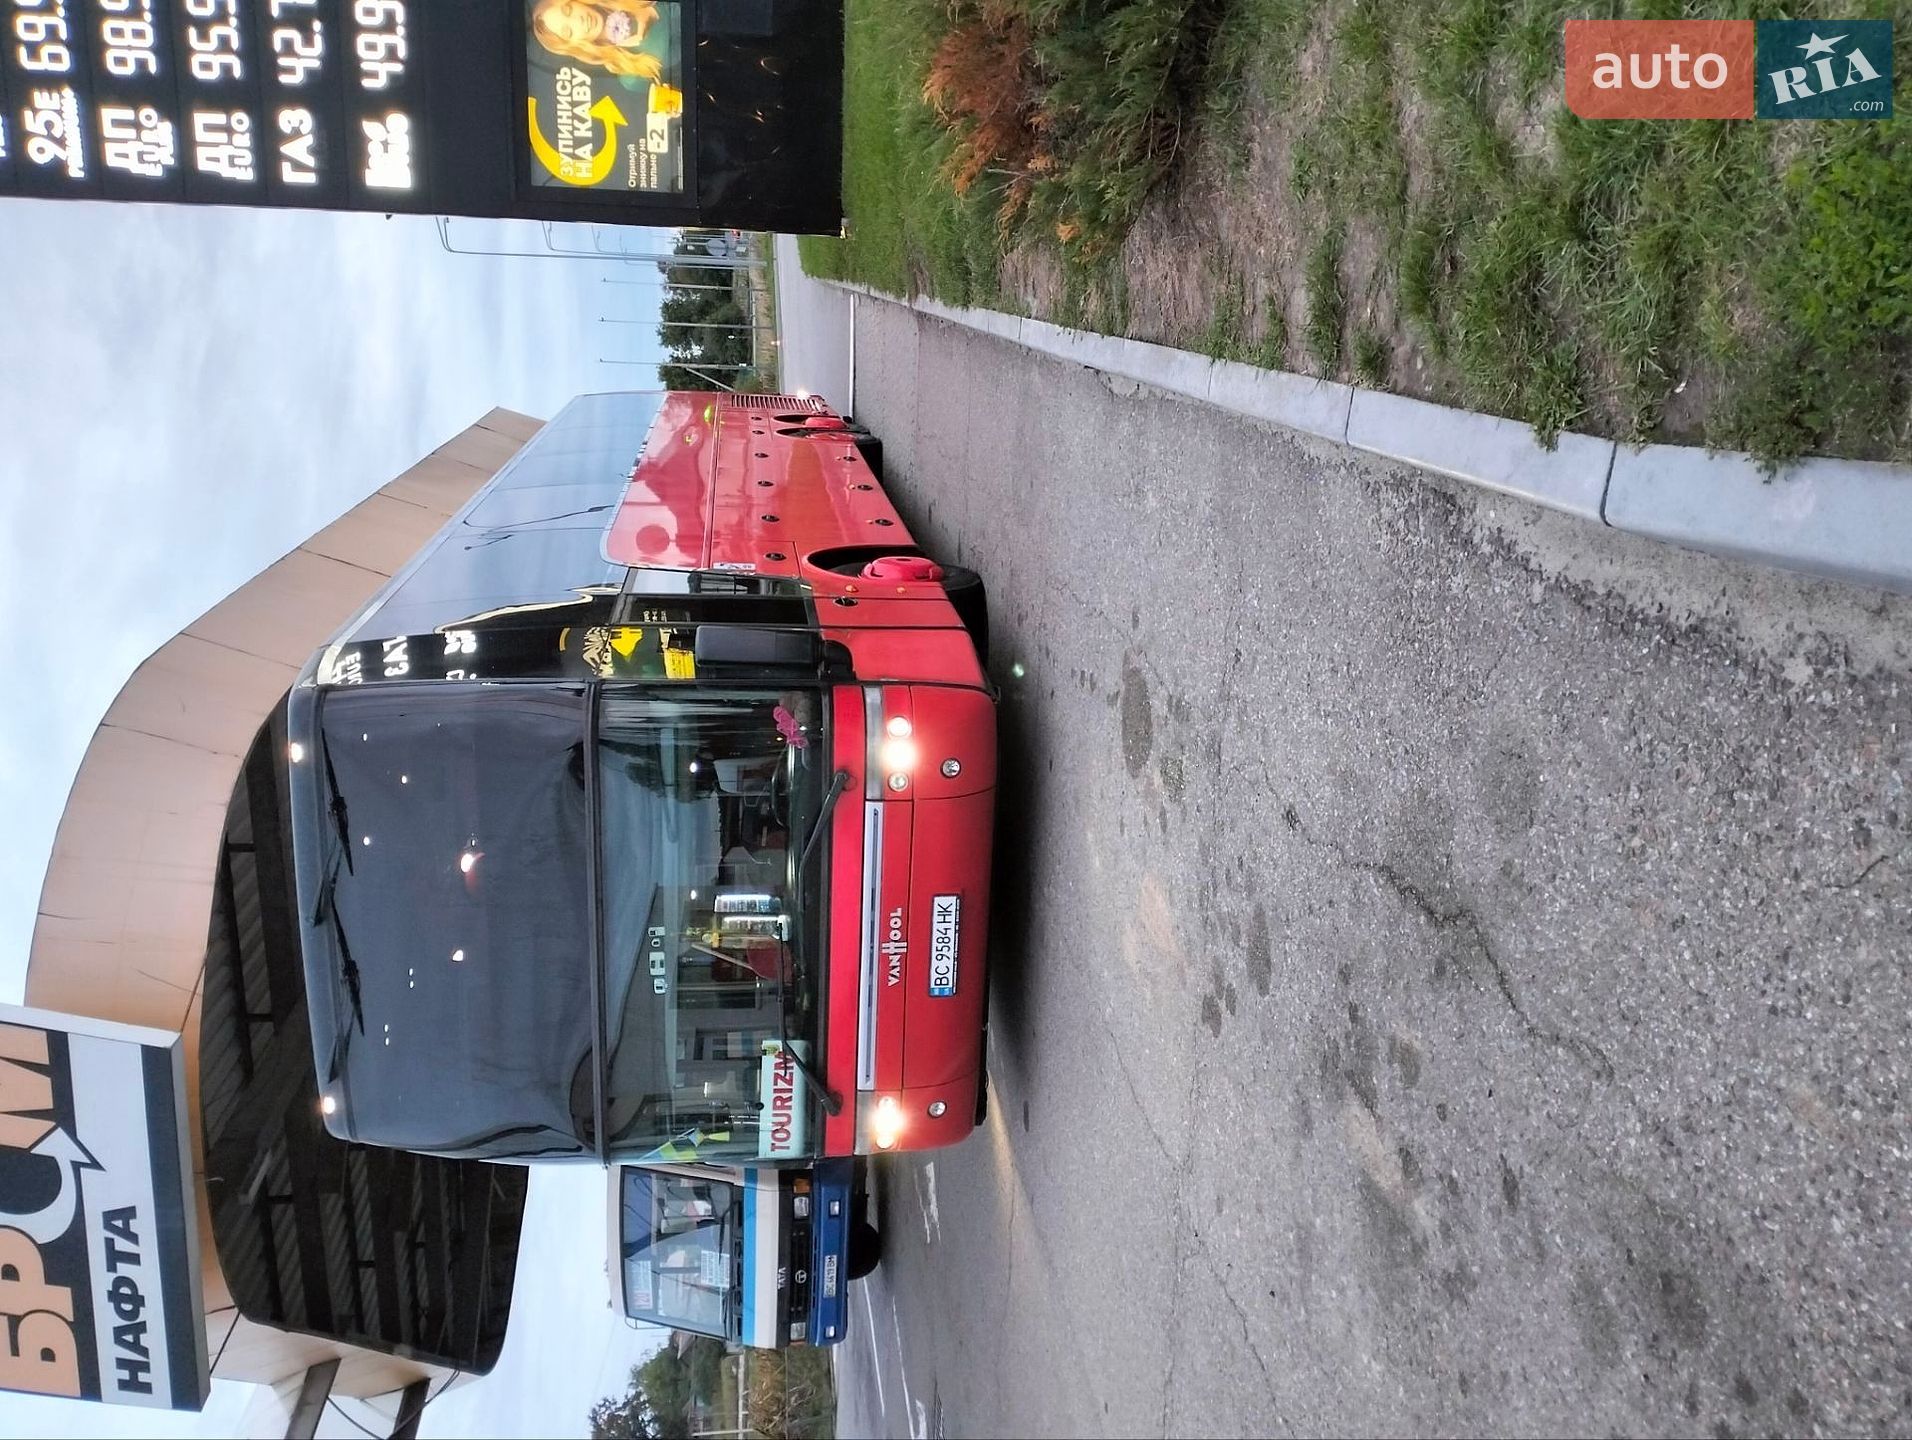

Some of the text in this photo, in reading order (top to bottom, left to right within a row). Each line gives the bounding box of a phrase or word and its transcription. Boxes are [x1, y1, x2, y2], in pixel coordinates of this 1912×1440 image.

[100, 107, 144, 174] ДП
[193, 111, 235, 178] ДП
[231, 111, 254, 181] EURO
[278, 107, 317, 184] ГАЗ
[556, 67, 575, 176] ЗУПИНИСЬ
[572, 67, 594, 178] НА КАВУ
[627, 144, 637, 188] Отримуй
[934, 902, 953, 987] BC 9584 HK
[102, 1205, 153, 1395] НАФТА
[777, 1266, 786, 1290] TATA
